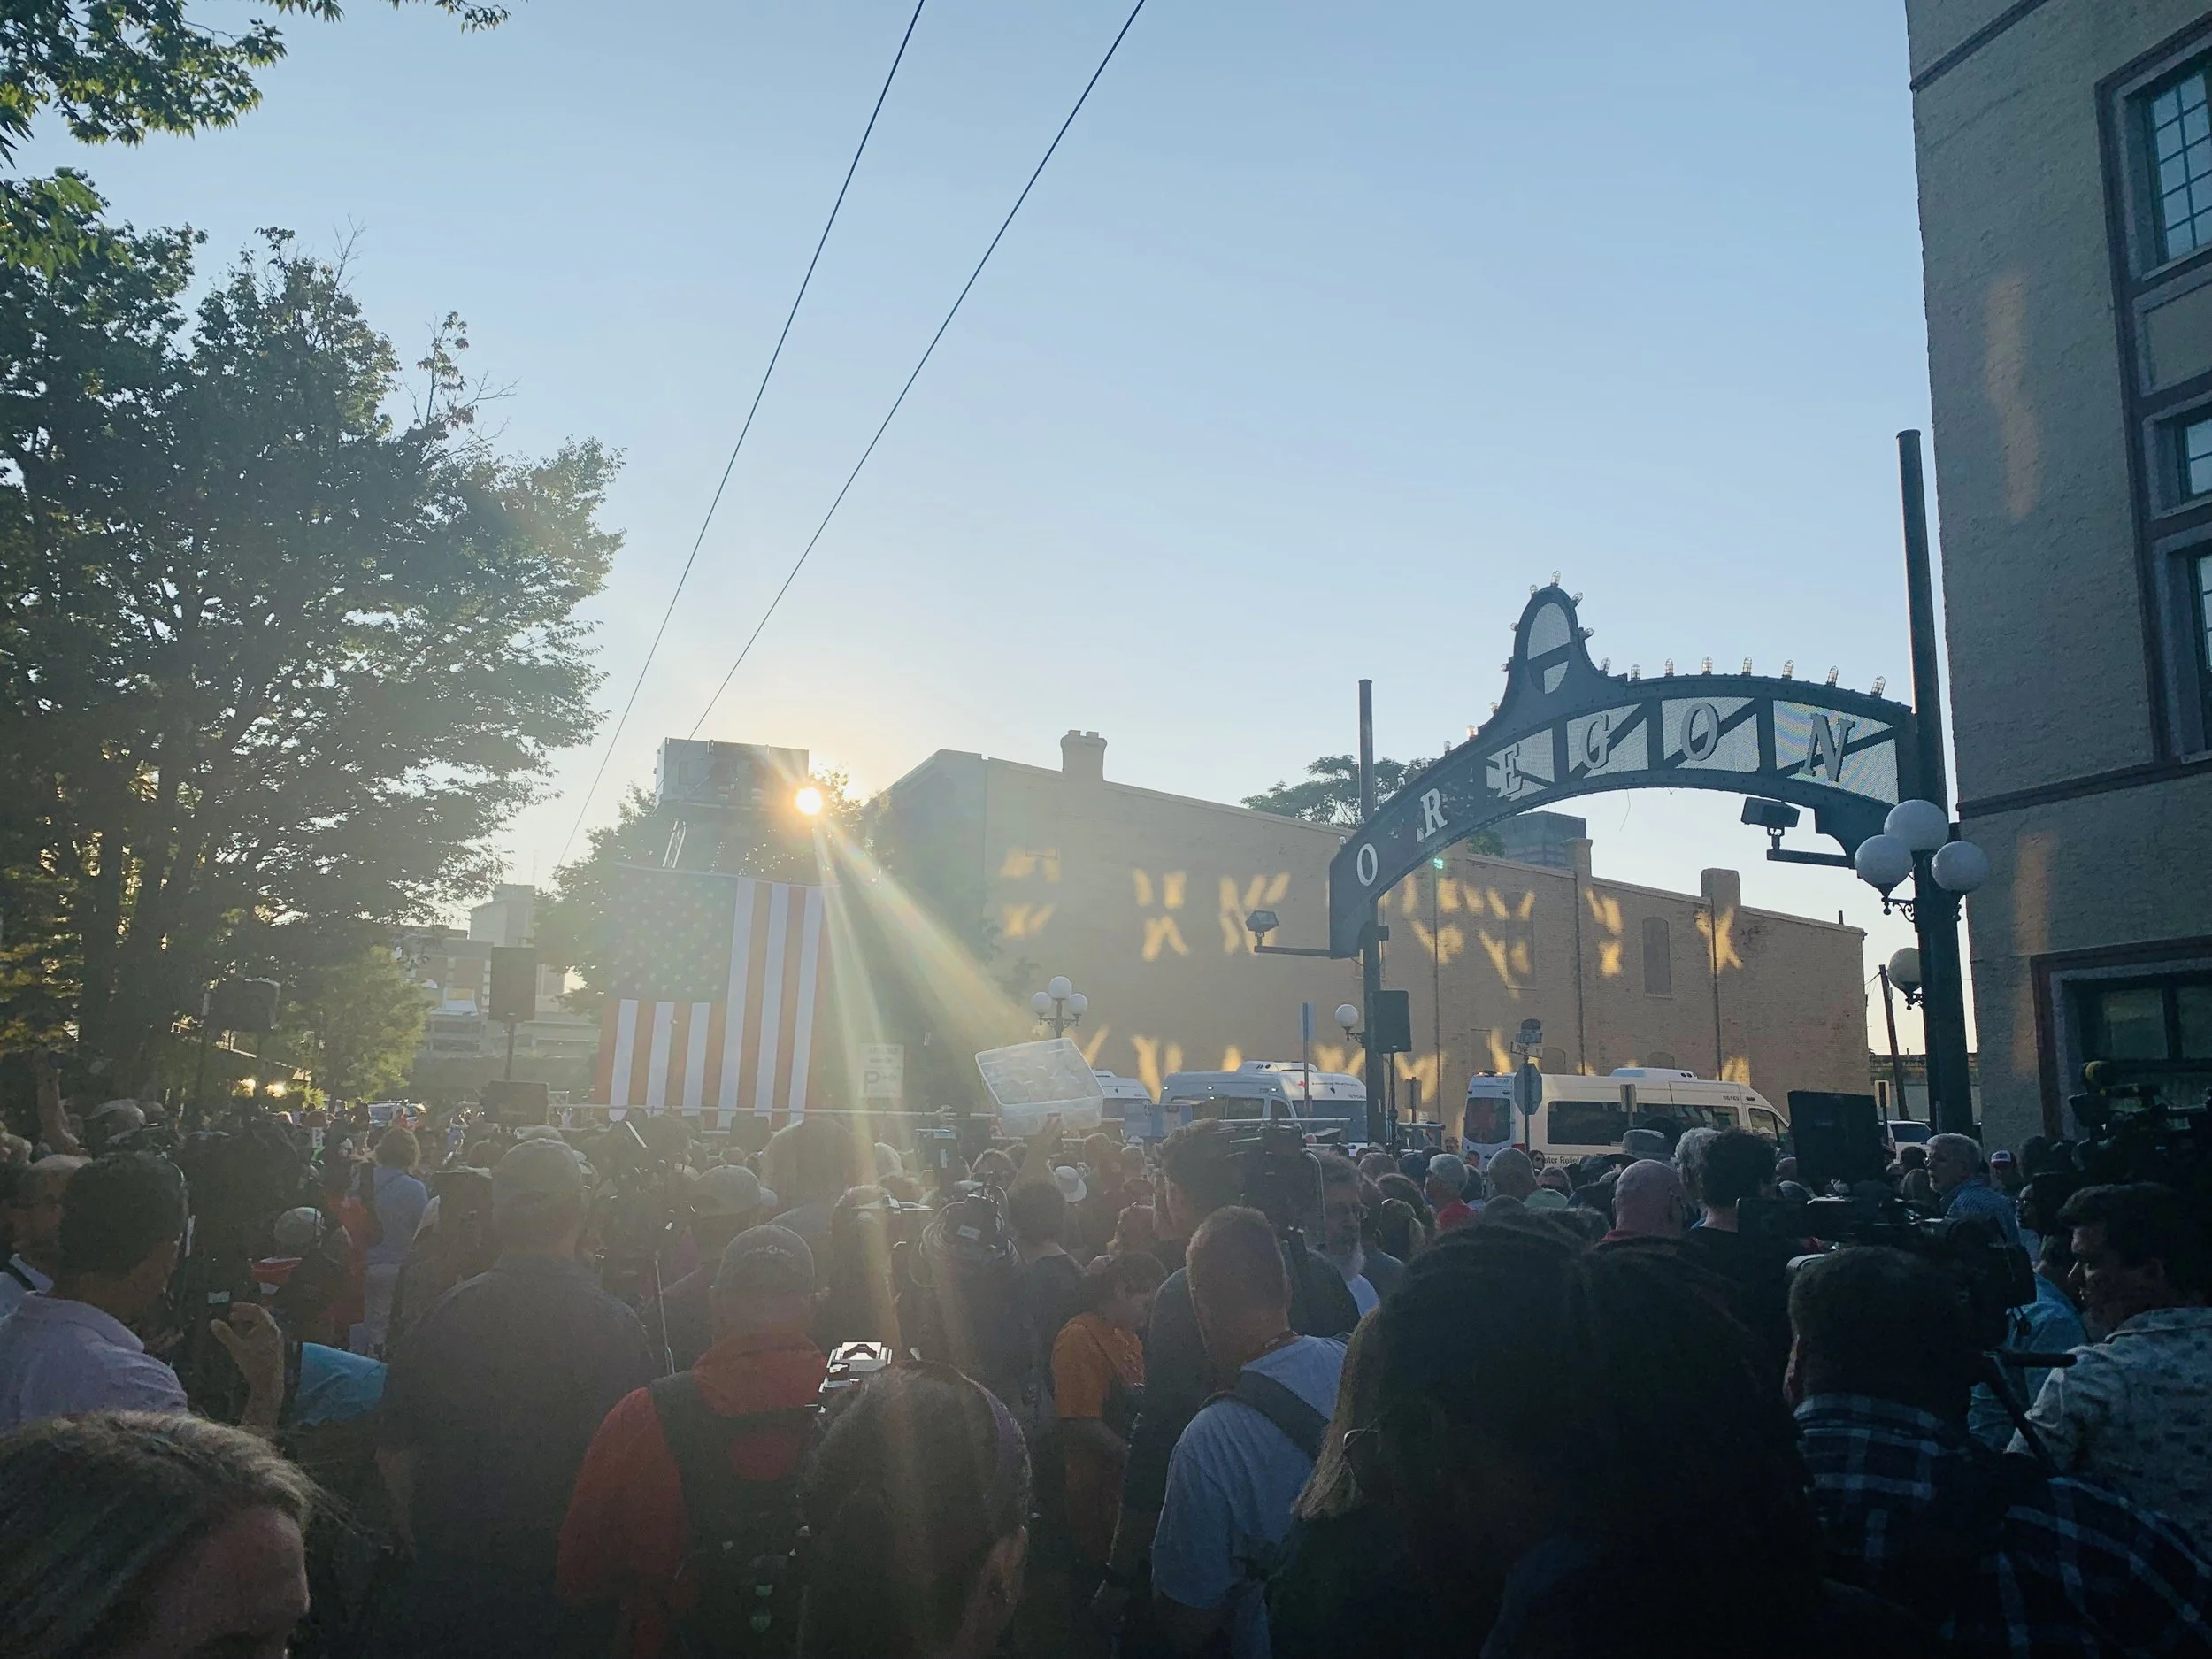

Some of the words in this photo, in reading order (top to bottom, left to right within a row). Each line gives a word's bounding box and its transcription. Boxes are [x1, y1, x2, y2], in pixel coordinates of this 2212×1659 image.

[1356, 702, 1856, 887] OREGON
[864, 1070, 880, 1093] P
[1543, 1156, 1558, 1164] ster
[1560, 1156, 1579, 1164] Relief
